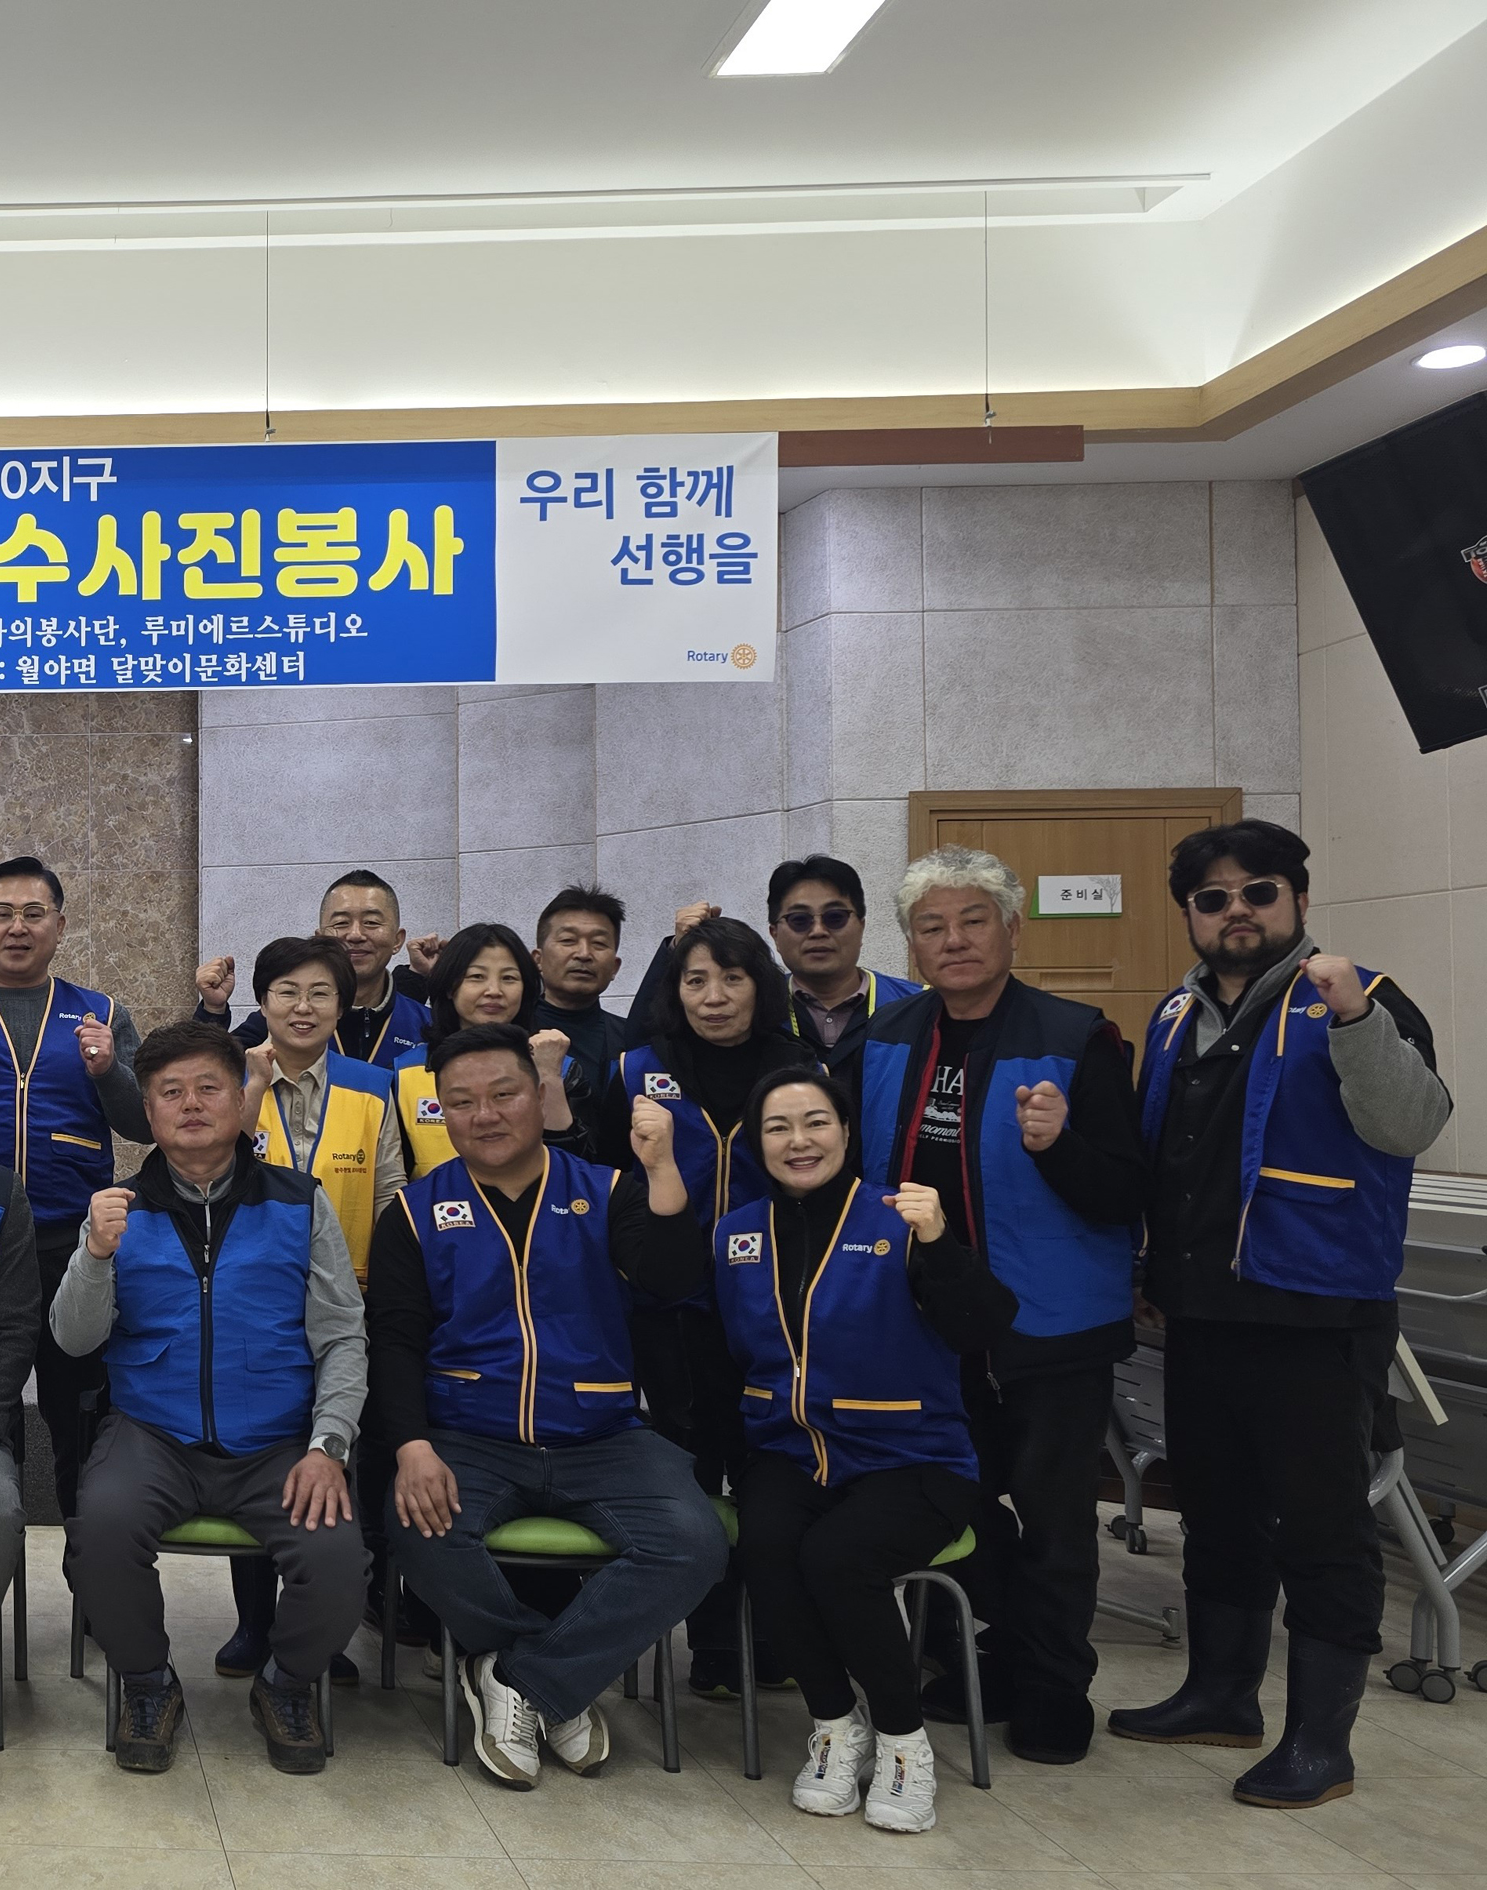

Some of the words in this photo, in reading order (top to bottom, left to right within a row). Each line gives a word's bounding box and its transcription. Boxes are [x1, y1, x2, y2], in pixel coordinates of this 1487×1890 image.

[520, 468, 614, 521] 우리
[636, 465, 734, 519] 함께
[610, 532, 759, 586] 선행을
[141, 612, 369, 645] 루미에르스튜디오
[15, 654, 98, 685] 월야면
[110, 651, 307, 683] 달맞이문화센터
[687, 650, 729, 664] Rotary
[394, 1037, 416, 1048] Rotary
[332, 1153, 356, 1161] Rotary
[842, 1243, 873, 1254] Rotary
